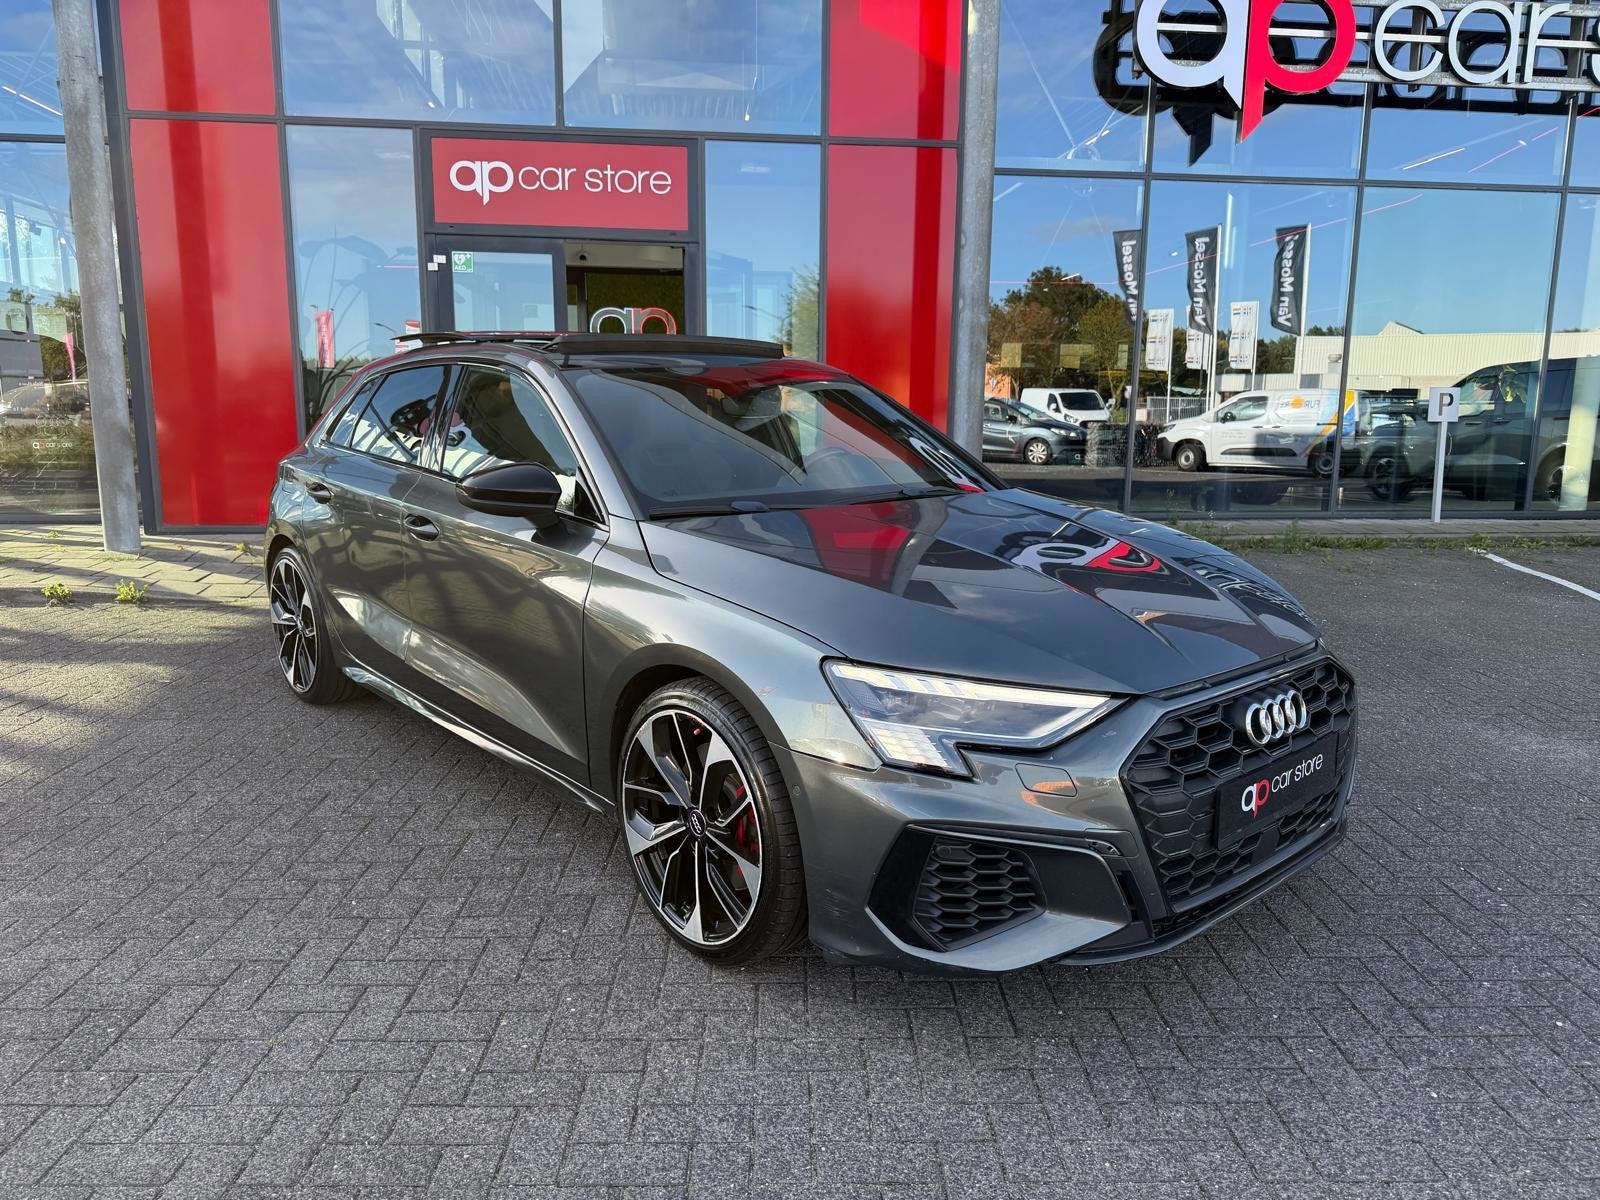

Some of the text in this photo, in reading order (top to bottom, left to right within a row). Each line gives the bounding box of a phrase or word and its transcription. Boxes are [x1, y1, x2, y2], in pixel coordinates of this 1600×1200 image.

[1373, 0, 1570, 84] car
[449, 160, 672, 206] ap car store
[1438, 392, 1454, 416] P
[1241, 754, 1323, 817] ap car store
